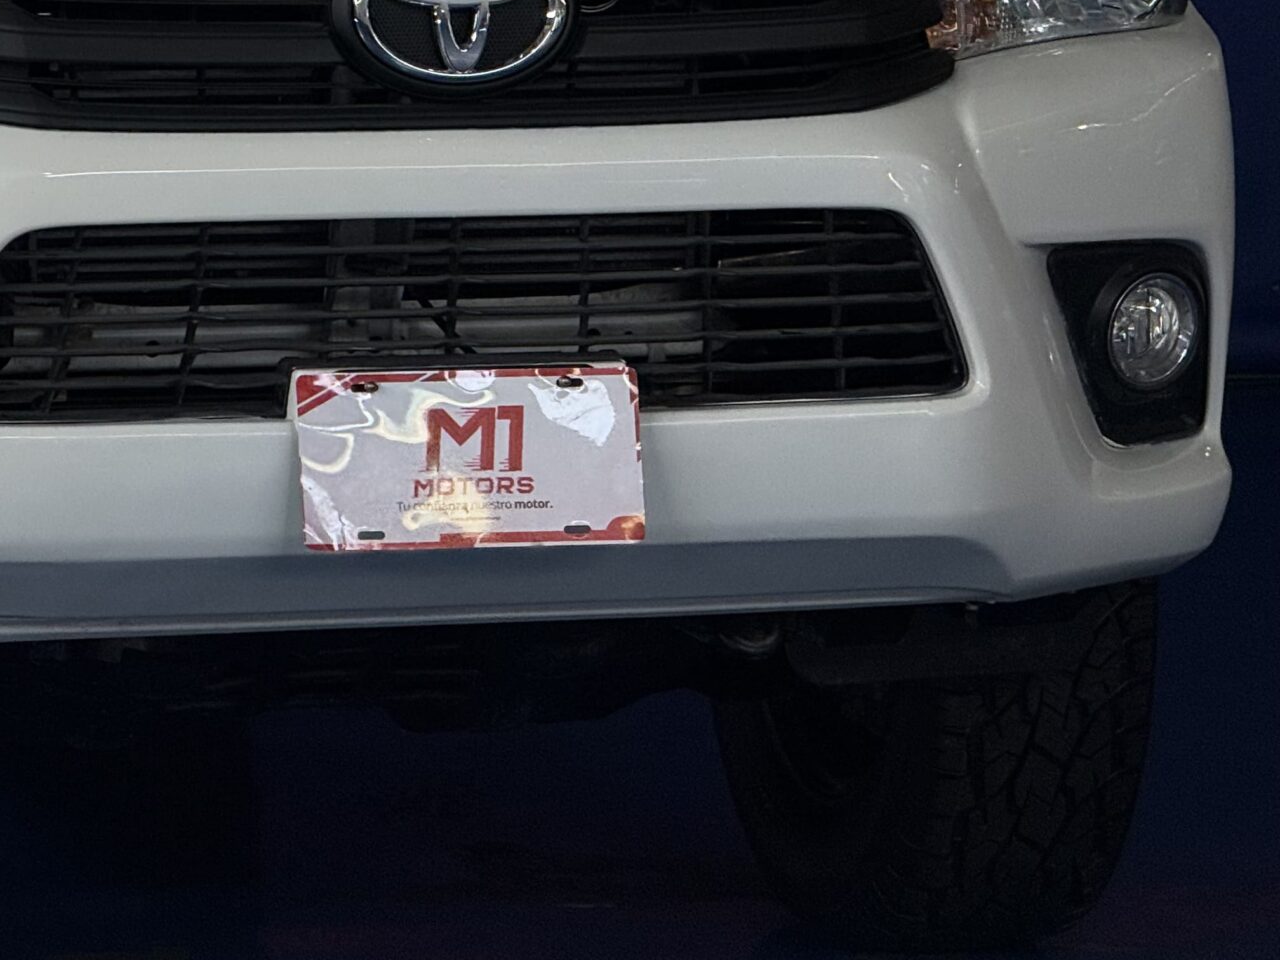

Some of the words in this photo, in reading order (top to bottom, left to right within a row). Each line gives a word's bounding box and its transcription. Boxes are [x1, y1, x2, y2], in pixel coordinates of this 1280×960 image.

[419, 405, 524, 471] M1
[412, 476, 535, 498] MOTORS
[514, 498, 554, 510] motor.
